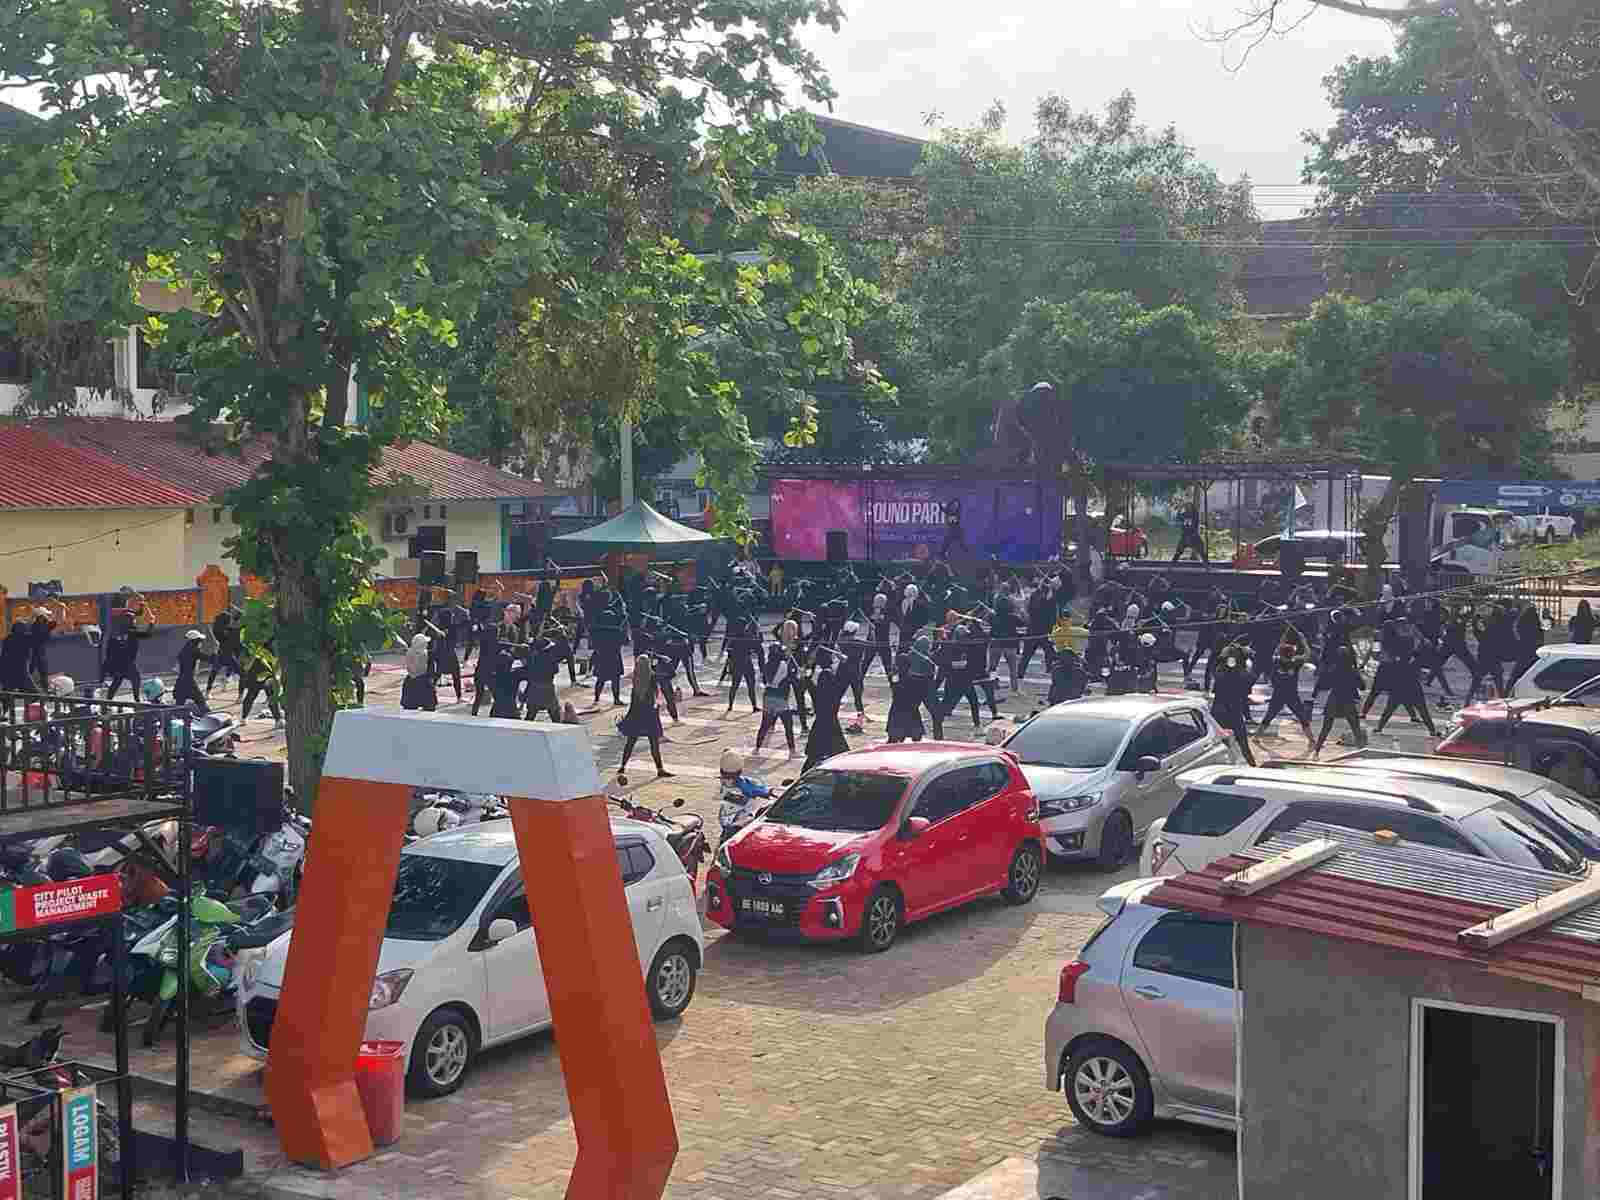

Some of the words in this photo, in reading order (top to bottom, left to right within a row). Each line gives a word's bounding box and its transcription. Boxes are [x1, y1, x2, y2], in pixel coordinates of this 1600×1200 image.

[35, 895, 77, 910] PROJECT
[78, 888, 109, 903] WASTE
[56, 886, 83, 898] PILOT
[35, 898, 97, 918] MANAGEMENT
[71, 1103, 90, 1163] LOGAM
